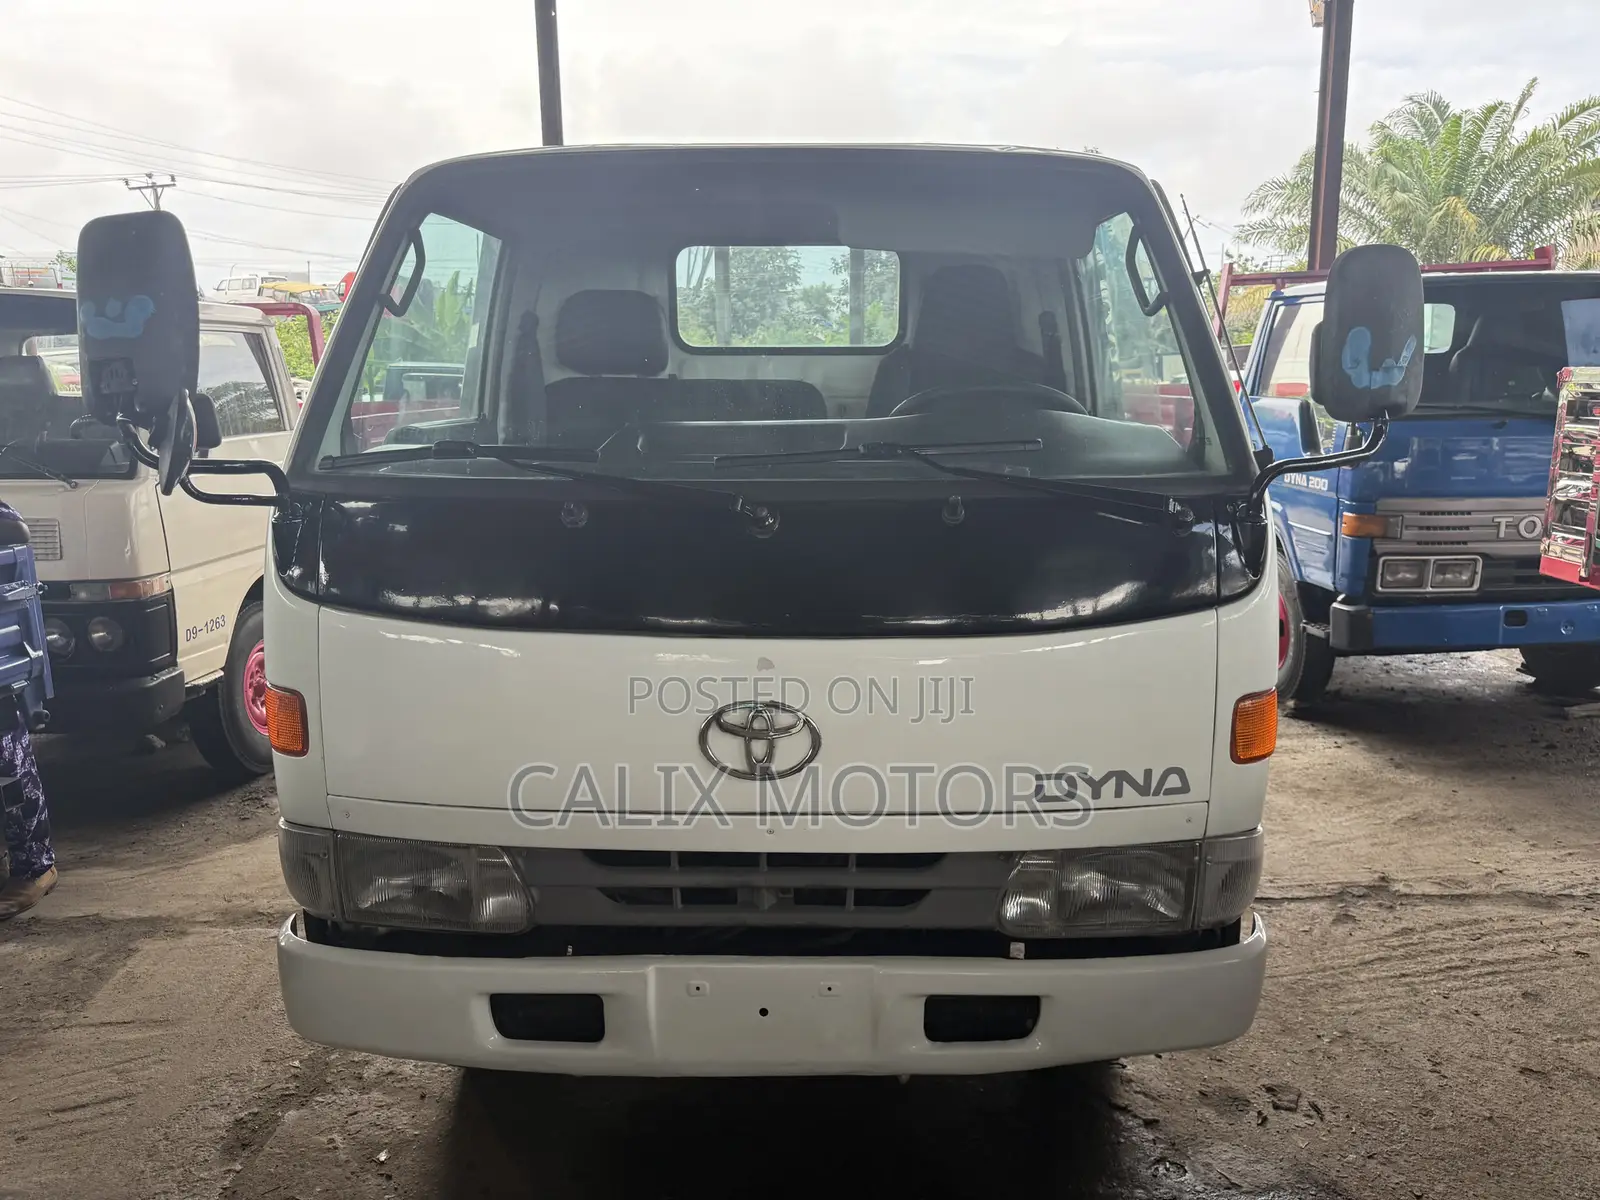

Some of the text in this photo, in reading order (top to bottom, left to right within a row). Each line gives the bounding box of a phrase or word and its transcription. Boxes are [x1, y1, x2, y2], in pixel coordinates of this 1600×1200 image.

[1283, 472, 1329, 491] DYNA 200
[185, 614, 226, 642] D9-1263
[1034, 766, 1191, 803] DYNA
